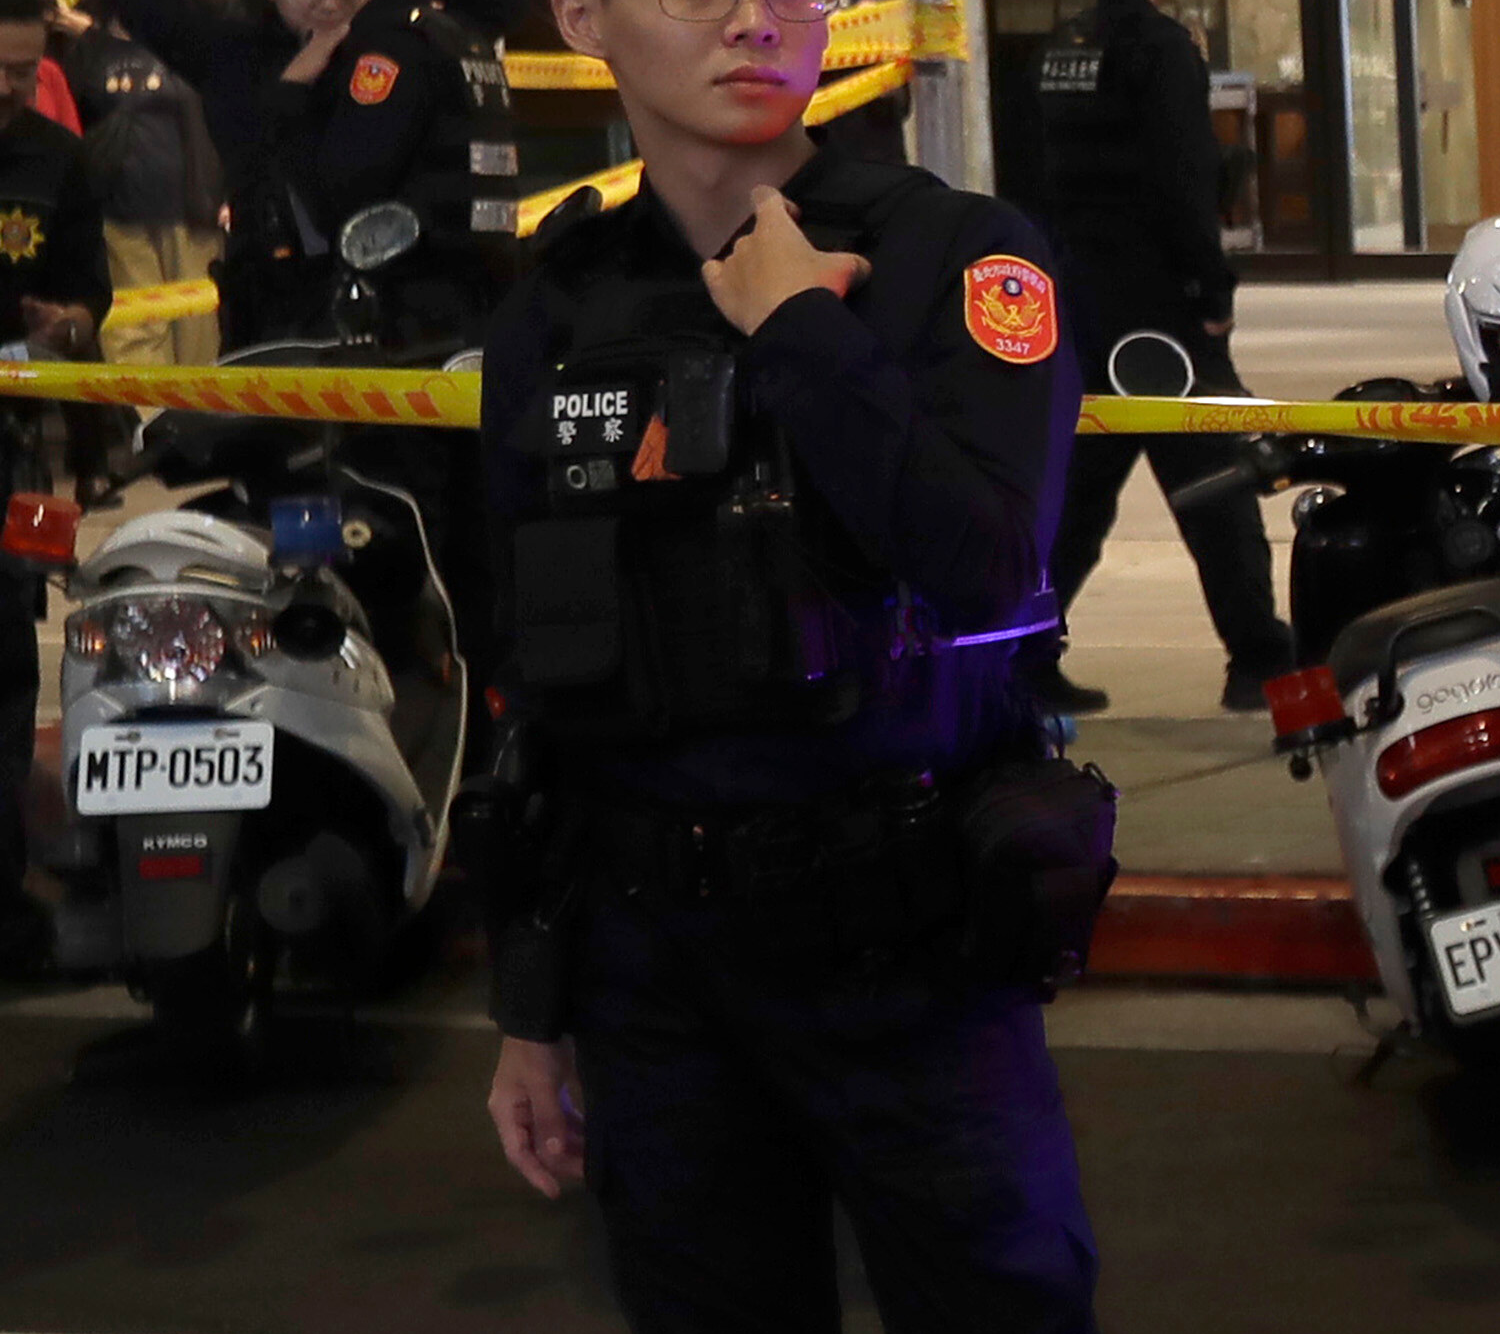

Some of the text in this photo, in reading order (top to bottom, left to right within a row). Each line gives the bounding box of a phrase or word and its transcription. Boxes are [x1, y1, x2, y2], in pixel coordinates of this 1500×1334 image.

[995, 338, 1031, 356] 3347
[552, 390, 629, 419] POLICE
[556, 417, 624, 446] 警察
